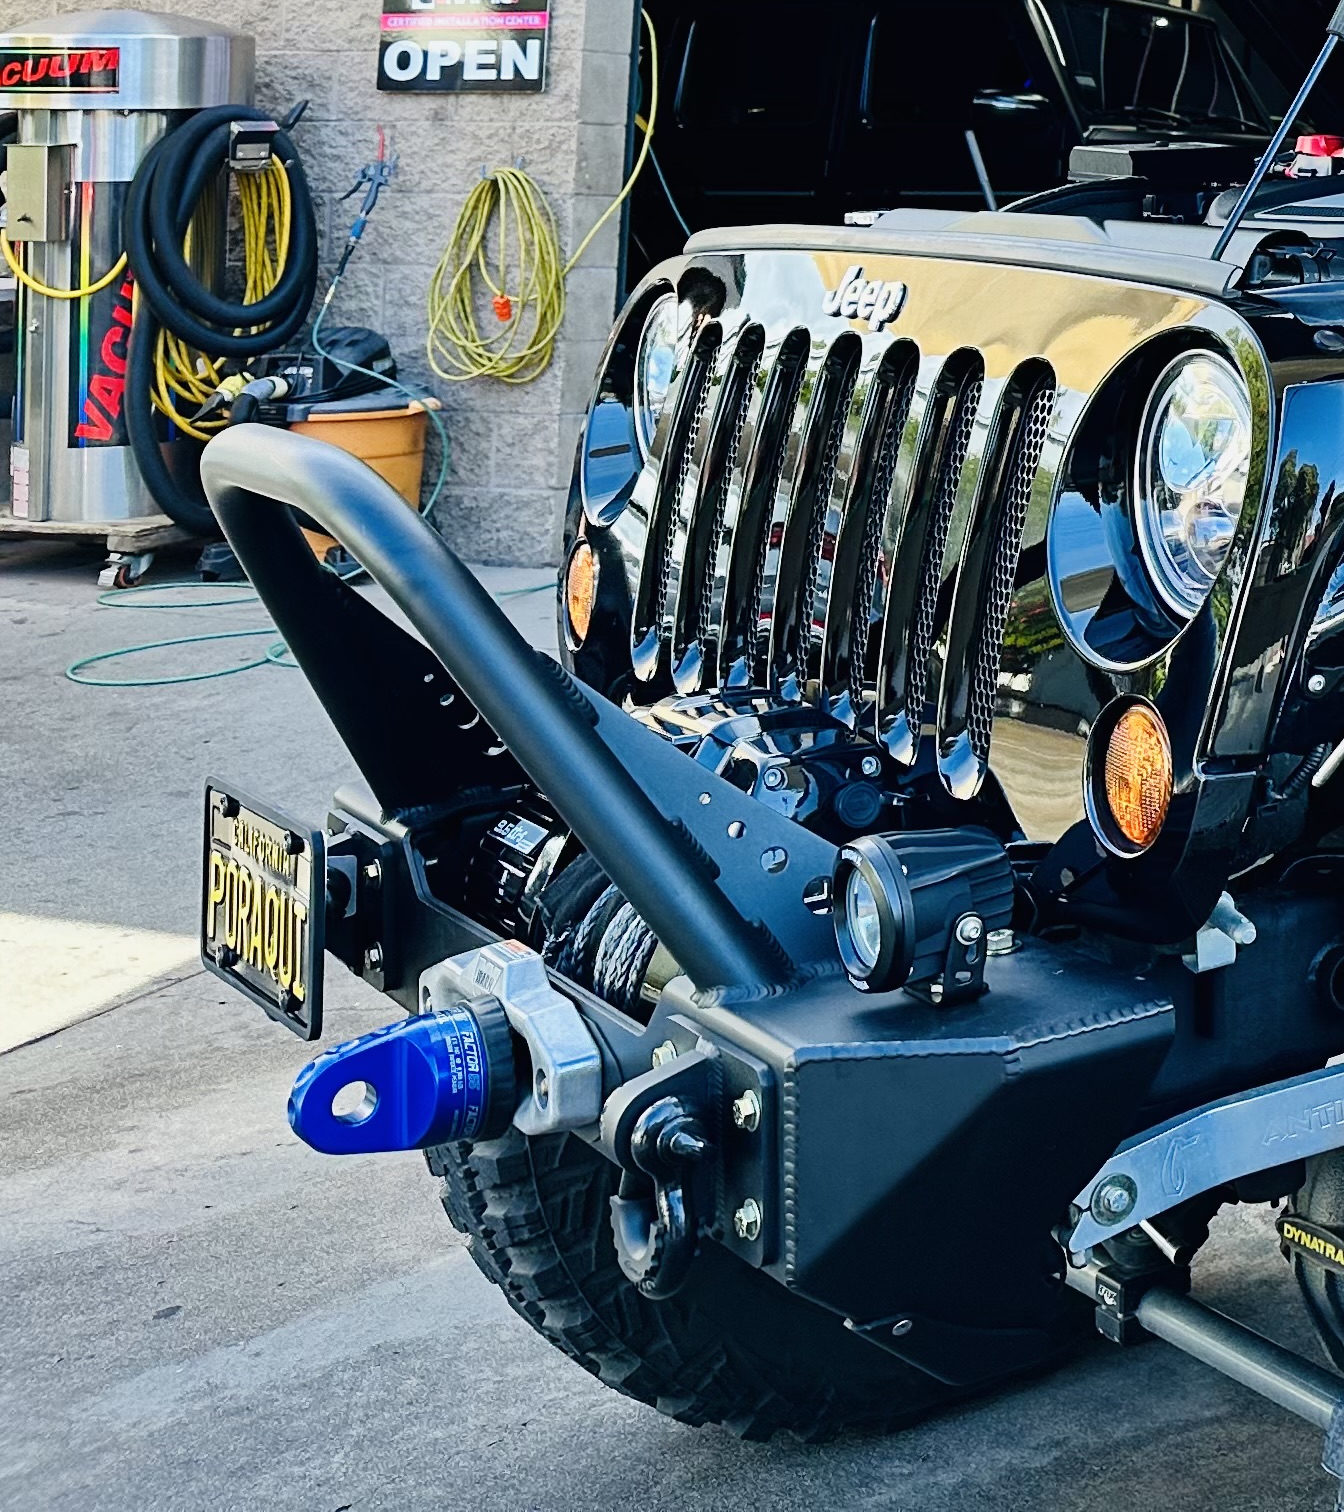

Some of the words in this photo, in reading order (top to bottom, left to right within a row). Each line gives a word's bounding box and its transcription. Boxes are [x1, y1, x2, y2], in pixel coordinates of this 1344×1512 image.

[0, 49, 119, 87] CUUM
[383, 39, 541, 81] OPEN
[822, 265, 908, 332] Jeep
[233, 816, 292, 879] CALIFORNIA
[206, 849, 307, 1002] PORAQUI
[461, 1031, 480, 1072] FACTOR
